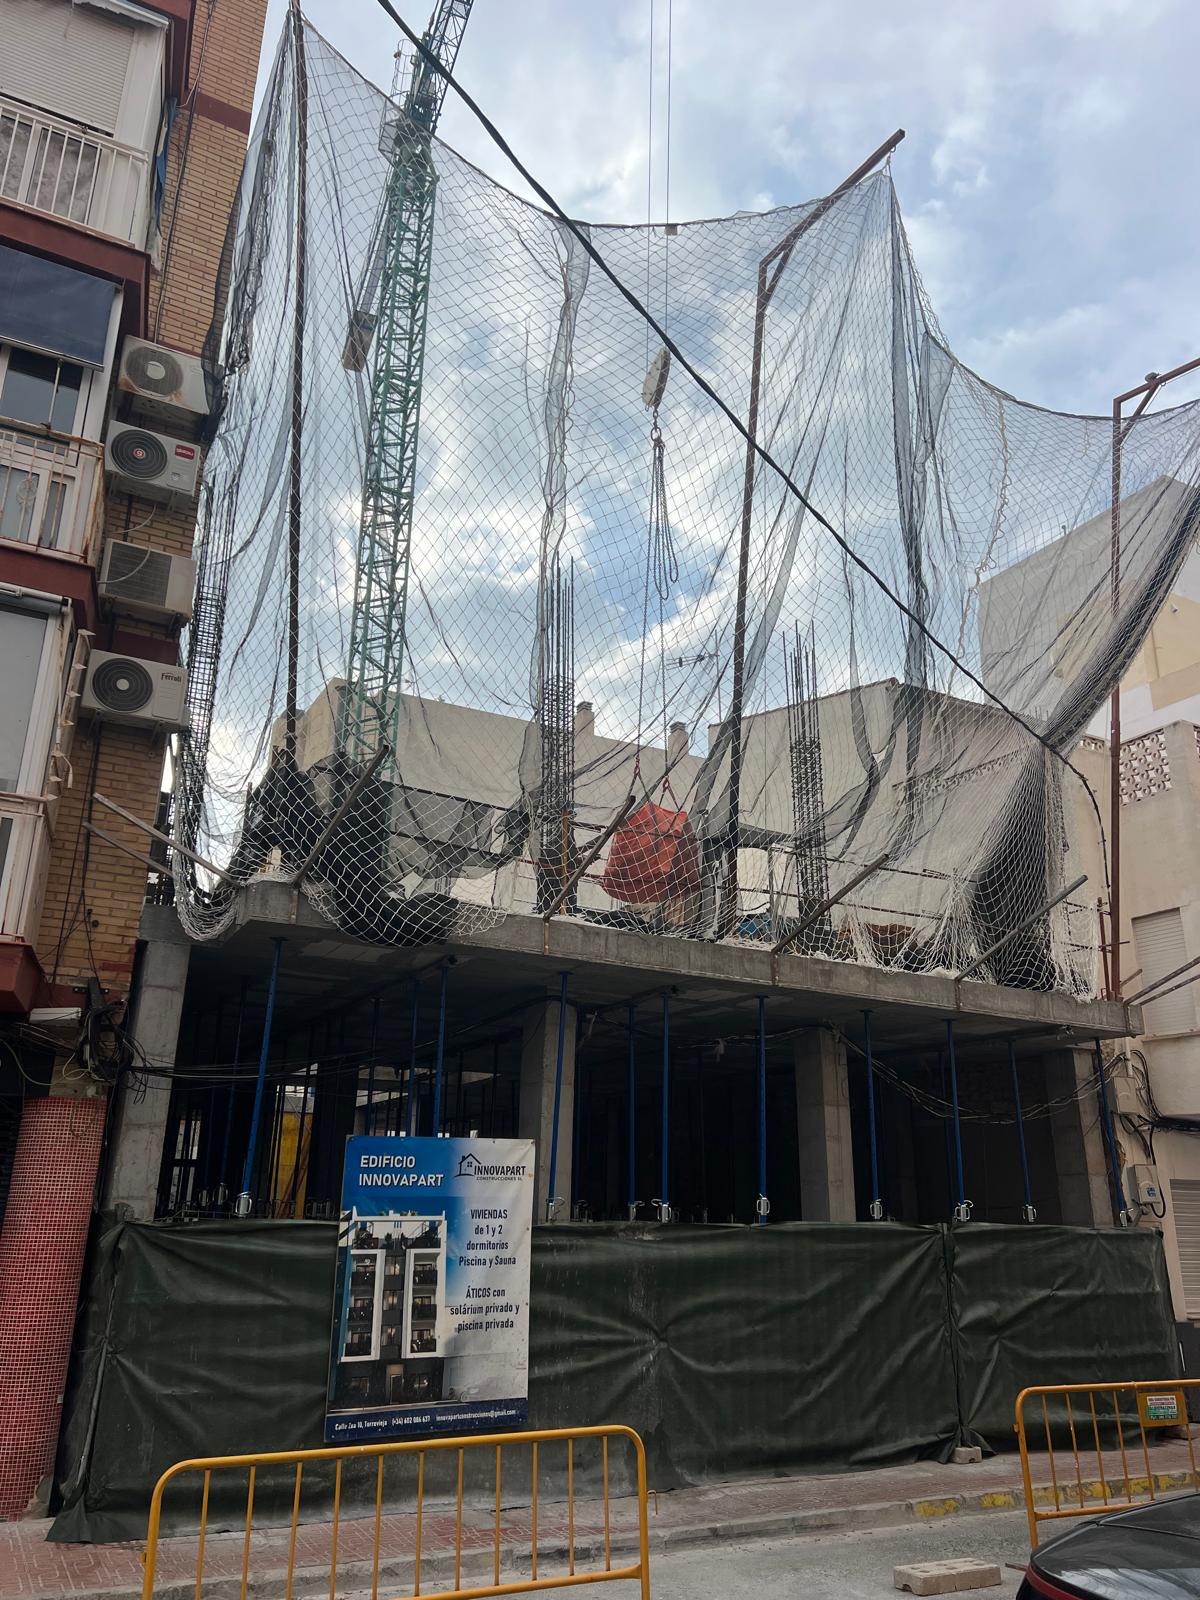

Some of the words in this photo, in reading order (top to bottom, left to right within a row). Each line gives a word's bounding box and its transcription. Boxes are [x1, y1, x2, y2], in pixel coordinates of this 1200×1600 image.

[360, 1155, 415, 1168] EDIFICIO
[474, 1165, 526, 1176] INNOVAPART
[359, 1173, 443, 1186] INNOVAPART
[470, 1209, 508, 1219] VIVIENDAS
[474, 1225, 484, 1234] de
[485, 1225, 490, 1234] 1
[492, 1227, 496, 1237] y
[498, 1225, 503, 1234] 2
[466, 1240, 509, 1250] dormitorios
[459, 1256, 487, 1266] Piscina
[489, 1259, 493, 1268] y
[494, 1255, 516, 1265] Sauna
[465, 1285, 491, 1298] ÁTICOS
[492, 1289, 506, 1297] con
[450, 1304, 484, 1315] solárium
[485, 1302, 513, 1316] privado
[515, 1305, 520, 1315] y
[457, 1320, 483, 1334] piscina
[485, 1318, 514, 1331] privada
[364, 1420, 387, 1428] Torrevieja
